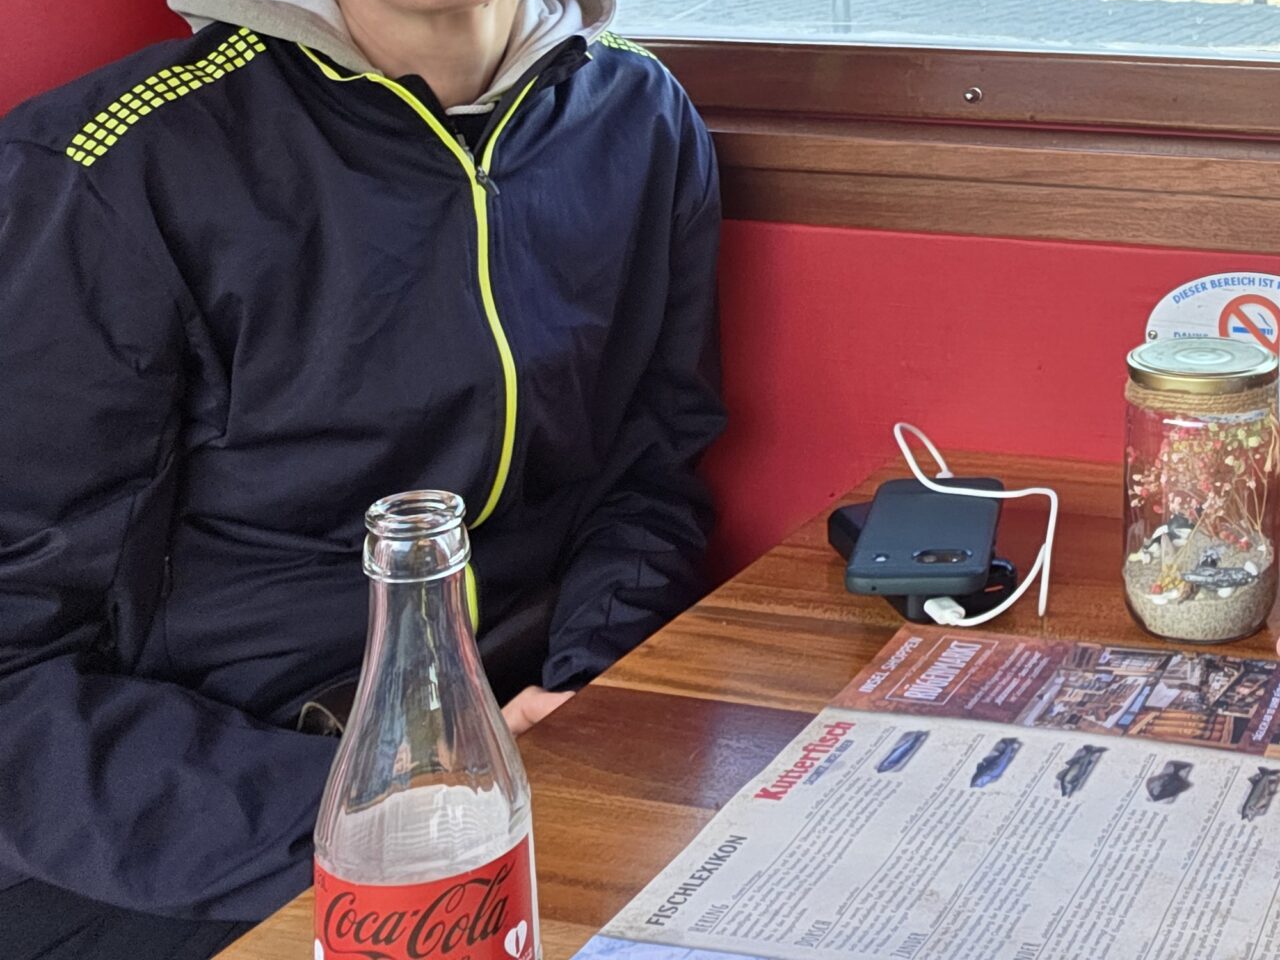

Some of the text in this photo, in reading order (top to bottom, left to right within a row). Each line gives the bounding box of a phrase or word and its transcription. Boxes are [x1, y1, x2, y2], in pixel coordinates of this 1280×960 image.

[1172, 282, 1208, 305] DIESER
[1210, 276, 1256, 289] BEREICH
[1258, 278, 1274, 289] IST
[859, 671, 890, 693] INSEL
[881, 636, 923, 671] SHOPPEN
[904, 640, 982, 700] RÜGENMARKT
[753, 721, 856, 801] Kutterfisch
[324, 858, 516, 959] Coca-Cola
[645, 834, 748, 926] FISCHLEXIKON
